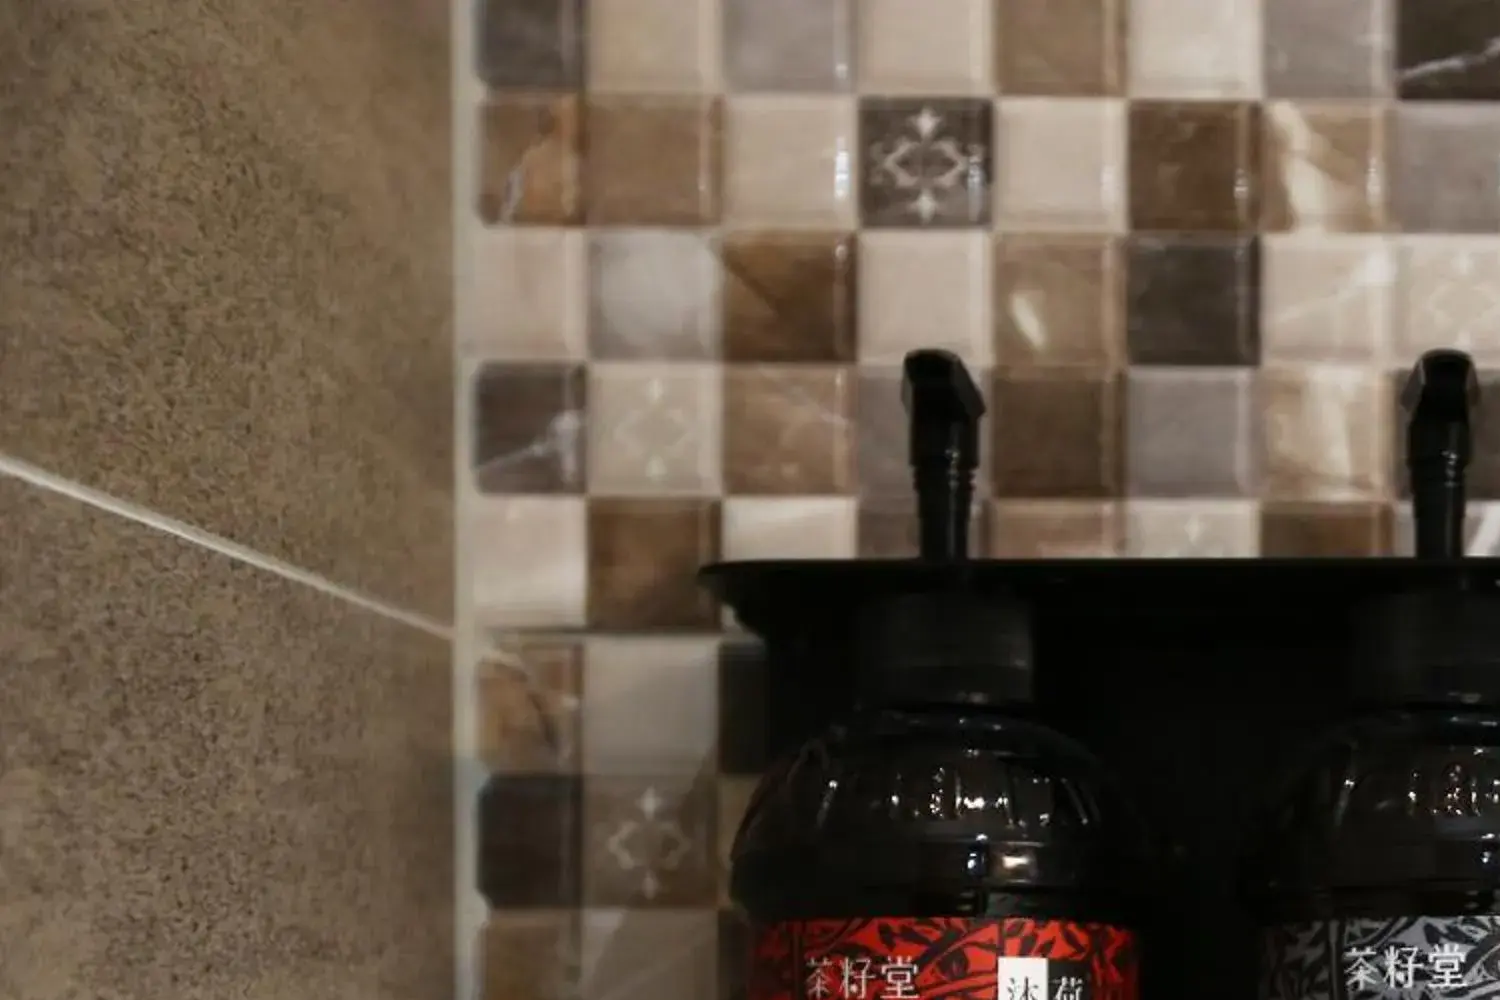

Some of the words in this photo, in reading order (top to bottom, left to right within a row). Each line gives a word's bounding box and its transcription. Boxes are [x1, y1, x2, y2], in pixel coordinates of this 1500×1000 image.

[804, 955, 920, 999] 茶籽堂
[1344, 944, 1467, 990] 茶籽堂
